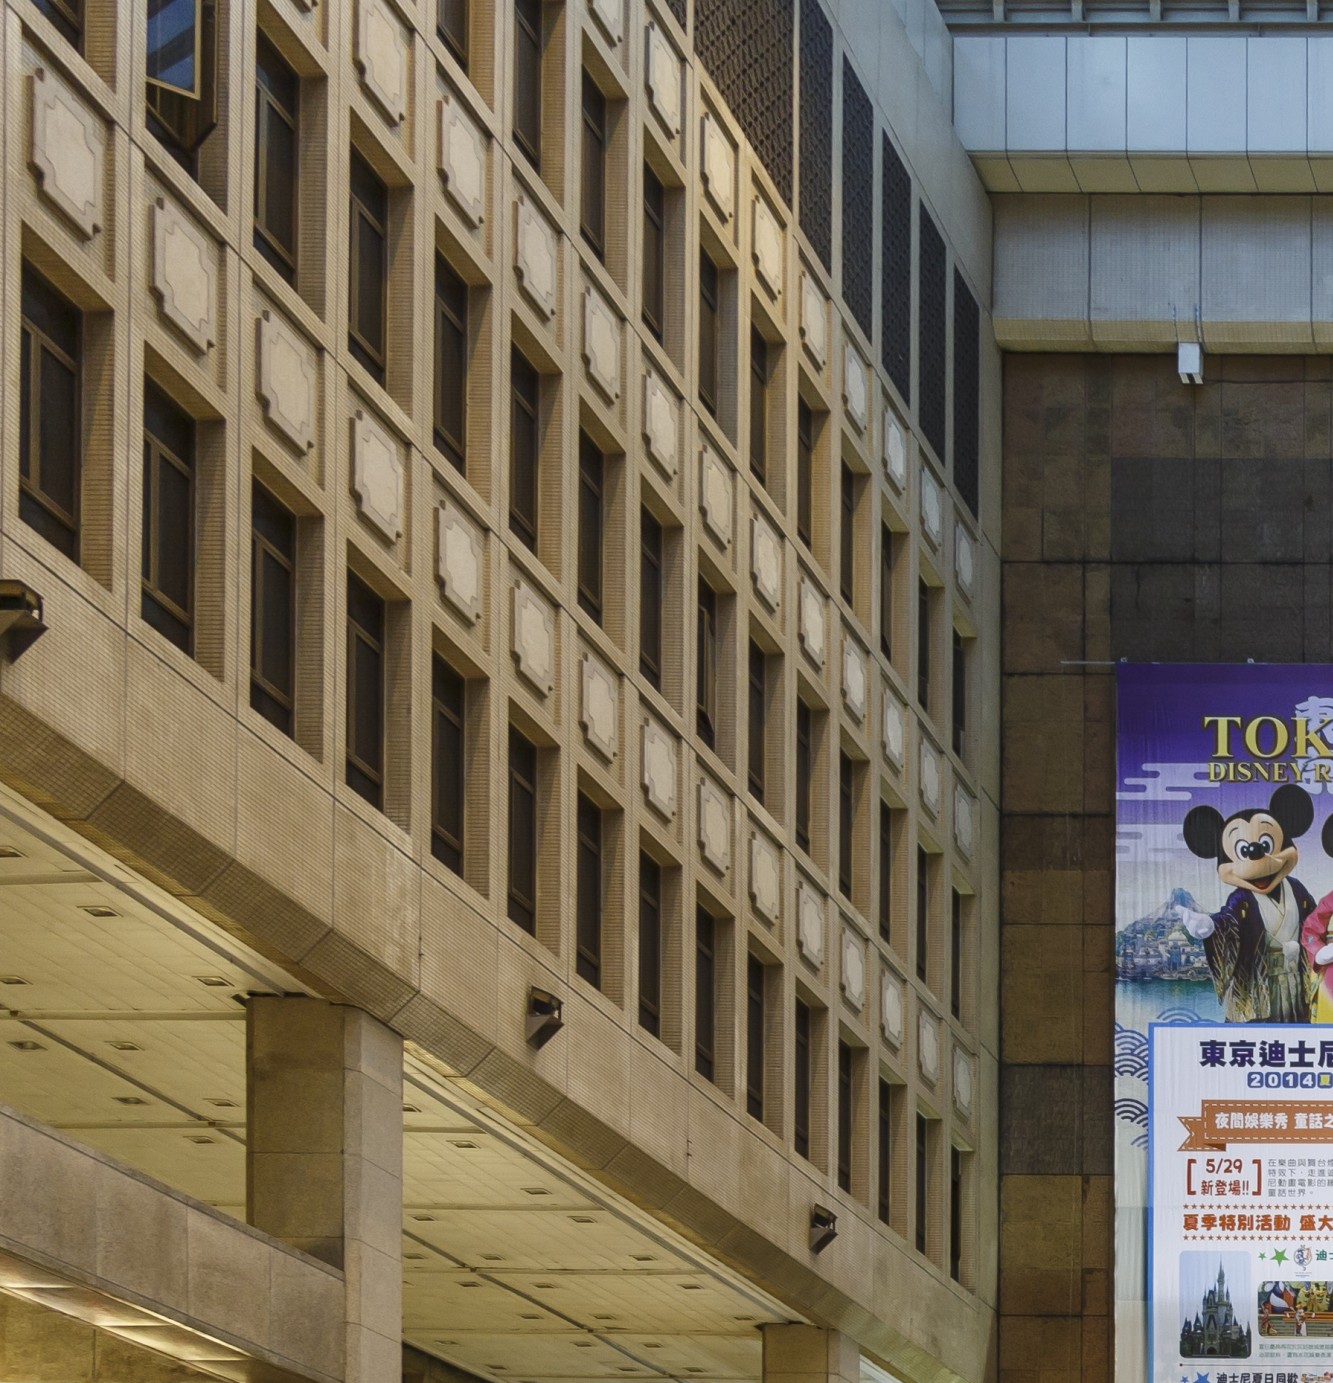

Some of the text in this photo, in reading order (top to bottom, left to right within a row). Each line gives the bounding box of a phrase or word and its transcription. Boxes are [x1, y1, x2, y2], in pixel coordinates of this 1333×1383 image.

[1208, 762, 1302, 783] DISNEY
[1206, 1159, 1243, 1174] 5/29
[1183, 1214, 1291, 1231] 夏季特別活動
